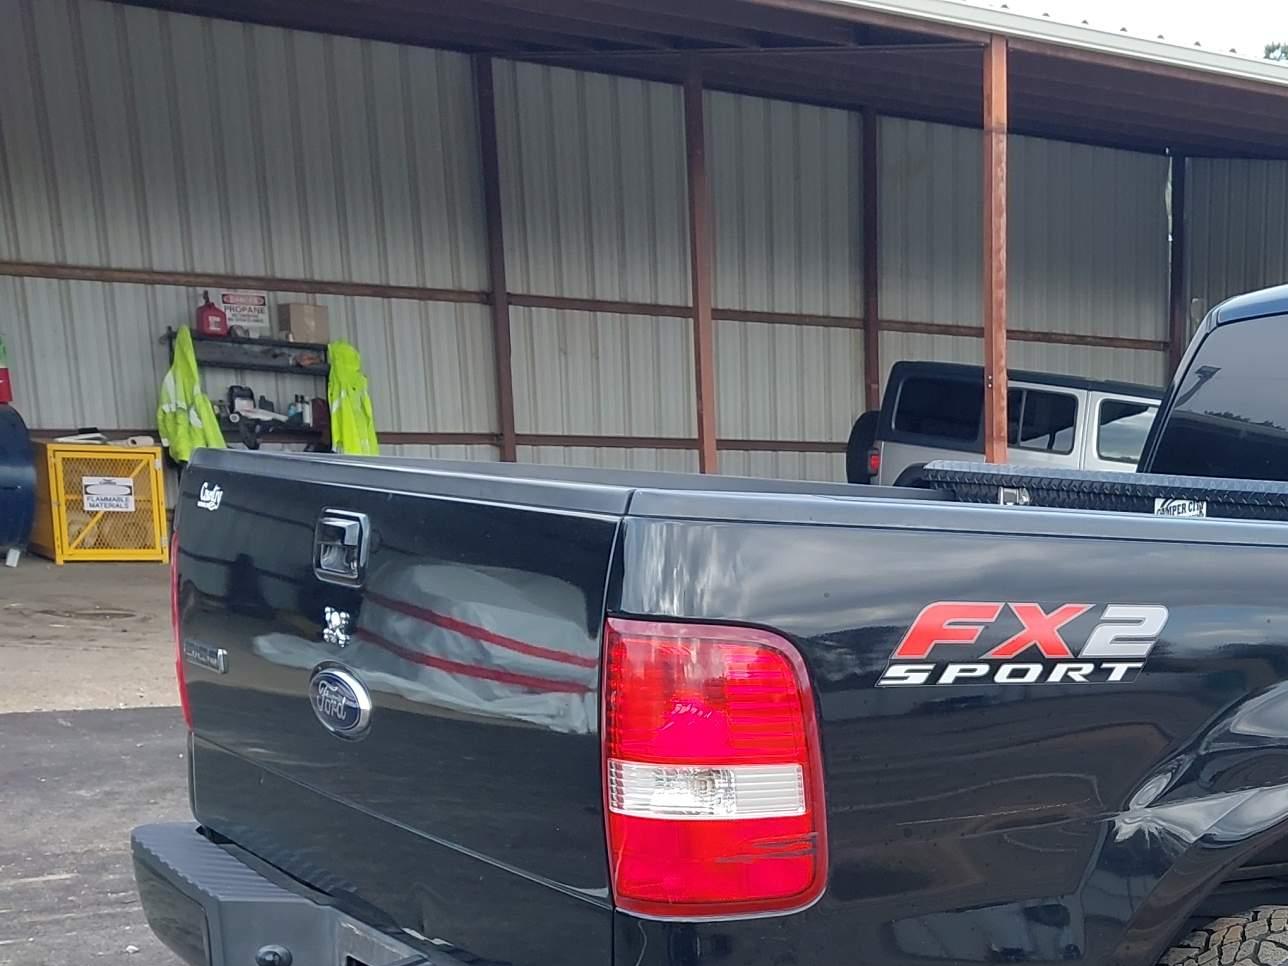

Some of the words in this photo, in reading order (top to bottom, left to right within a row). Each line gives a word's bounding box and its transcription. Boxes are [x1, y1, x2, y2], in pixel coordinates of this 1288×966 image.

[224, 305, 265, 315] PROPANE
[890, 601, 1169, 660] FX2
[876, 661, 1146, 686] SPORT
[316, 680, 347, 721] Ford
